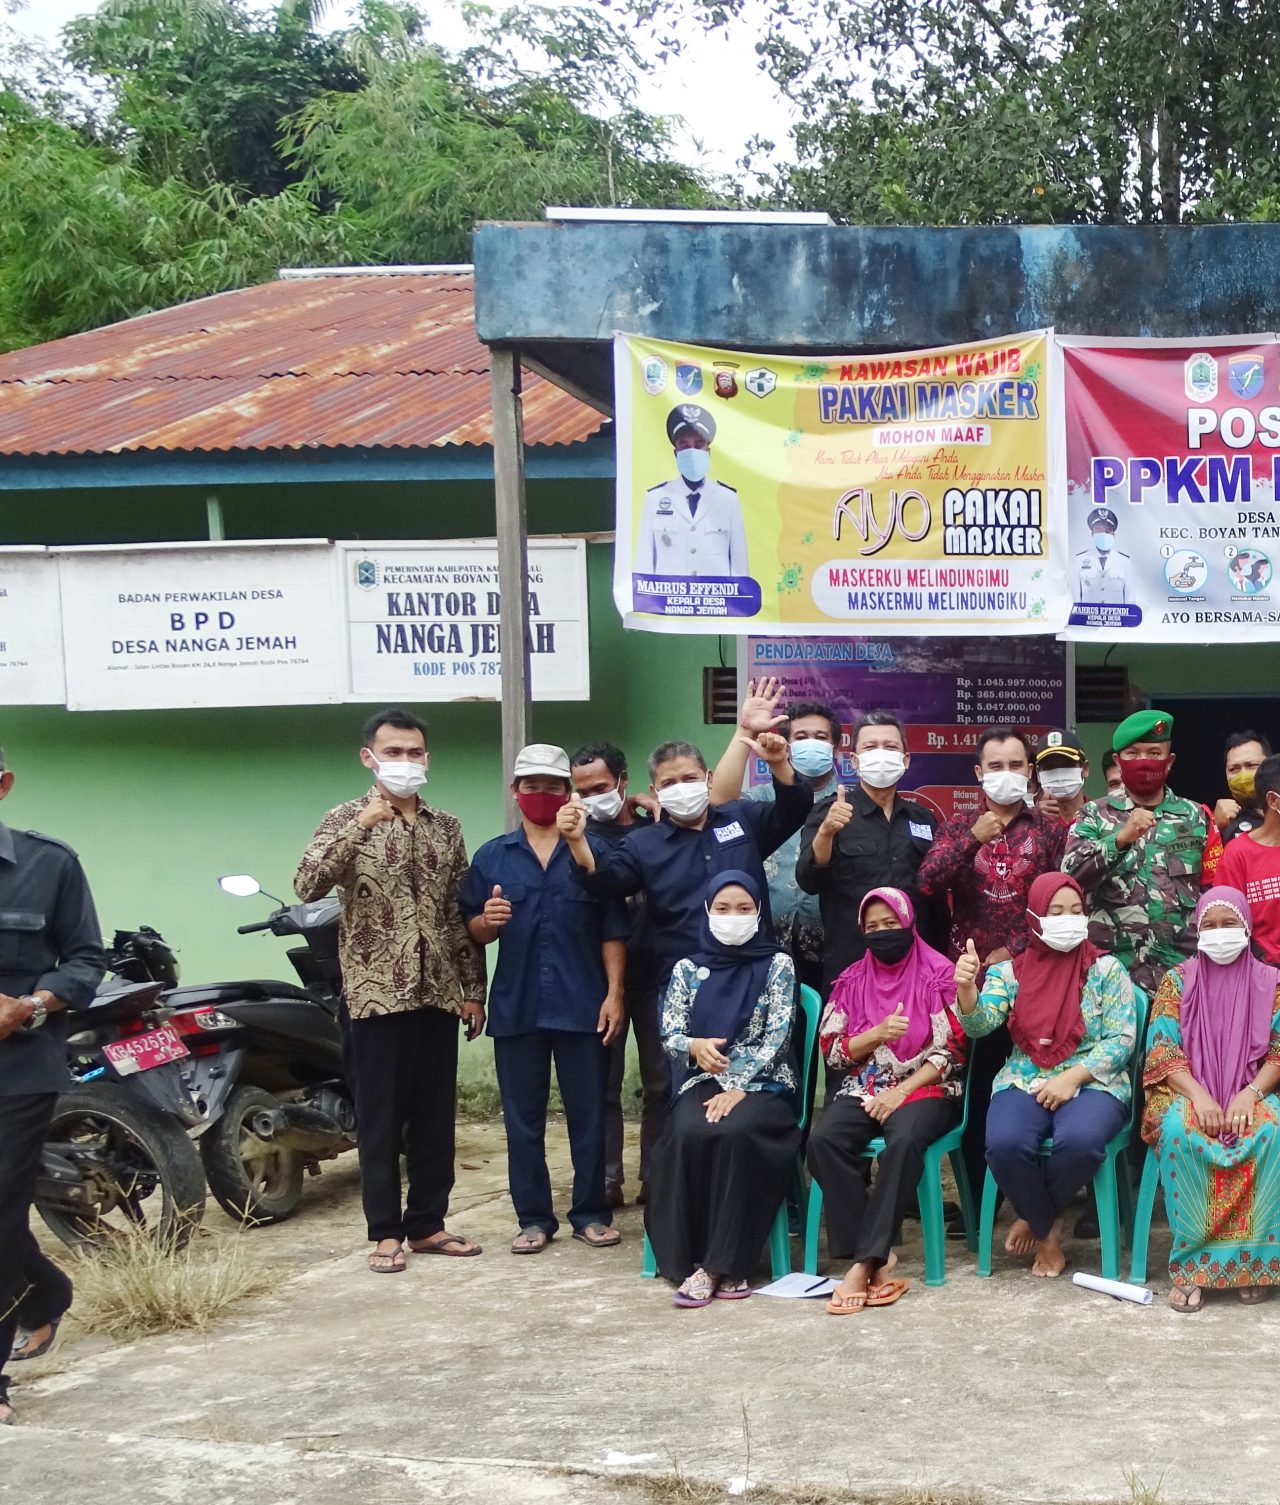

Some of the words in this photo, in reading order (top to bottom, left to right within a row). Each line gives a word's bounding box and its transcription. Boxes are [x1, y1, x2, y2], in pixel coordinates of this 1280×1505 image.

[840, 357, 947, 381] KAWASAN
[954, 349, 1021, 376] WAJIB
[818, 383, 910, 423] PAKAI
[917, 380, 1038, 421] MASKER
[879, 430, 935, 445] MOHON
[940, 428, 984, 443] MAAF
[932, 448, 958, 463] Anda
[896, 466, 922, 480] Anda
[926, 464, 950, 480] Tidak
[952, 465, 1010, 486] Menggunakan
[1014, 466, 1045, 482] Masker
[1092, 455, 1251, 504] PPKM
[943, 488, 1042, 526] PAKAI
[1238, 512, 1276, 524] DESA
[1160, 525, 1193, 539] KEC.
[1198, 525, 1248, 538] BOYAN
[944, 526, 1043, 556] MASKER
[1164, 546, 1170, 556] 1
[1228, 546, 1234, 557] 2
[384, 574, 448, 584] KECAMATAN
[453, 574, 492, 584] BOYAN
[830, 568, 901, 588] MASKERKU
[908, 568, 1009, 587] MELINDUNGIMU
[637, 580, 686, 594] MAHRUS
[690, 583, 738, 595] EFFENDI
[118, 593, 161, 604] BADAN
[165, 591, 247, 602] PERWAKILAN
[251, 590, 284, 600] DESA
[387, 592, 476, 616] KANTOR
[667, 597, 700, 606] KEPALA
[703, 598, 726, 606] DESA
[848, 592, 924, 612] MASKERMU
[929, 592, 1026, 610] MELINDUNGIKU
[665, 606, 694, 614] NANGA
[696, 607, 728, 615] JEMAH
[1162, 612, 1190, 623] AYO
[112, 640, 158, 654] DESA
[165, 638, 230, 652] NANGA
[236, 636, 297, 651] JEMAH
[376, 624, 464, 654] NANGA
[754, 643, 852, 660] PENDAPATAN
[856, 643, 892, 660] DESA
[414, 662, 446, 676] KODE
[956, 678, 974, 688] Rp.
[956, 690, 974, 700] Rp.
[956, 702, 974, 712] Rp.
[956, 714, 974, 724] Rp.
[928, 733, 948, 748] Rp.
[954, 791, 978, 800] Bidang
